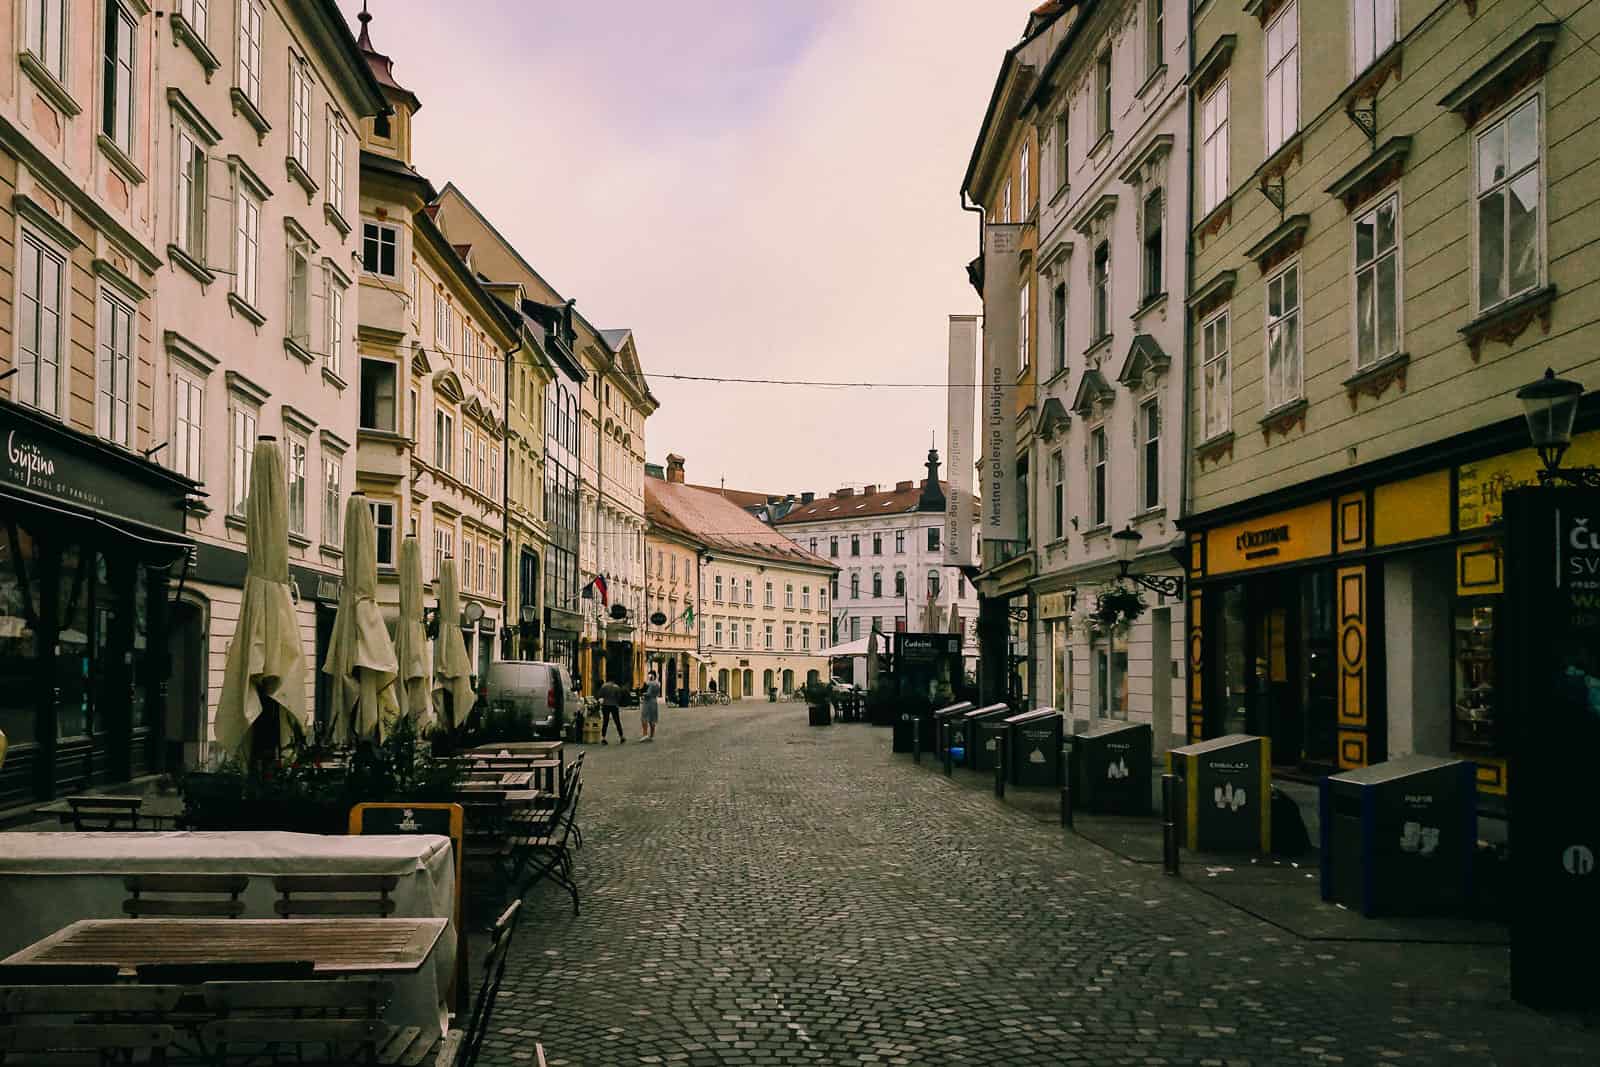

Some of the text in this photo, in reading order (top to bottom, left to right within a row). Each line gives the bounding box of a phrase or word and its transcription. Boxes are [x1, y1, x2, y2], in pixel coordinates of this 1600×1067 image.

[989, 367, 1004, 528] Mestna galerija Ljubljana
